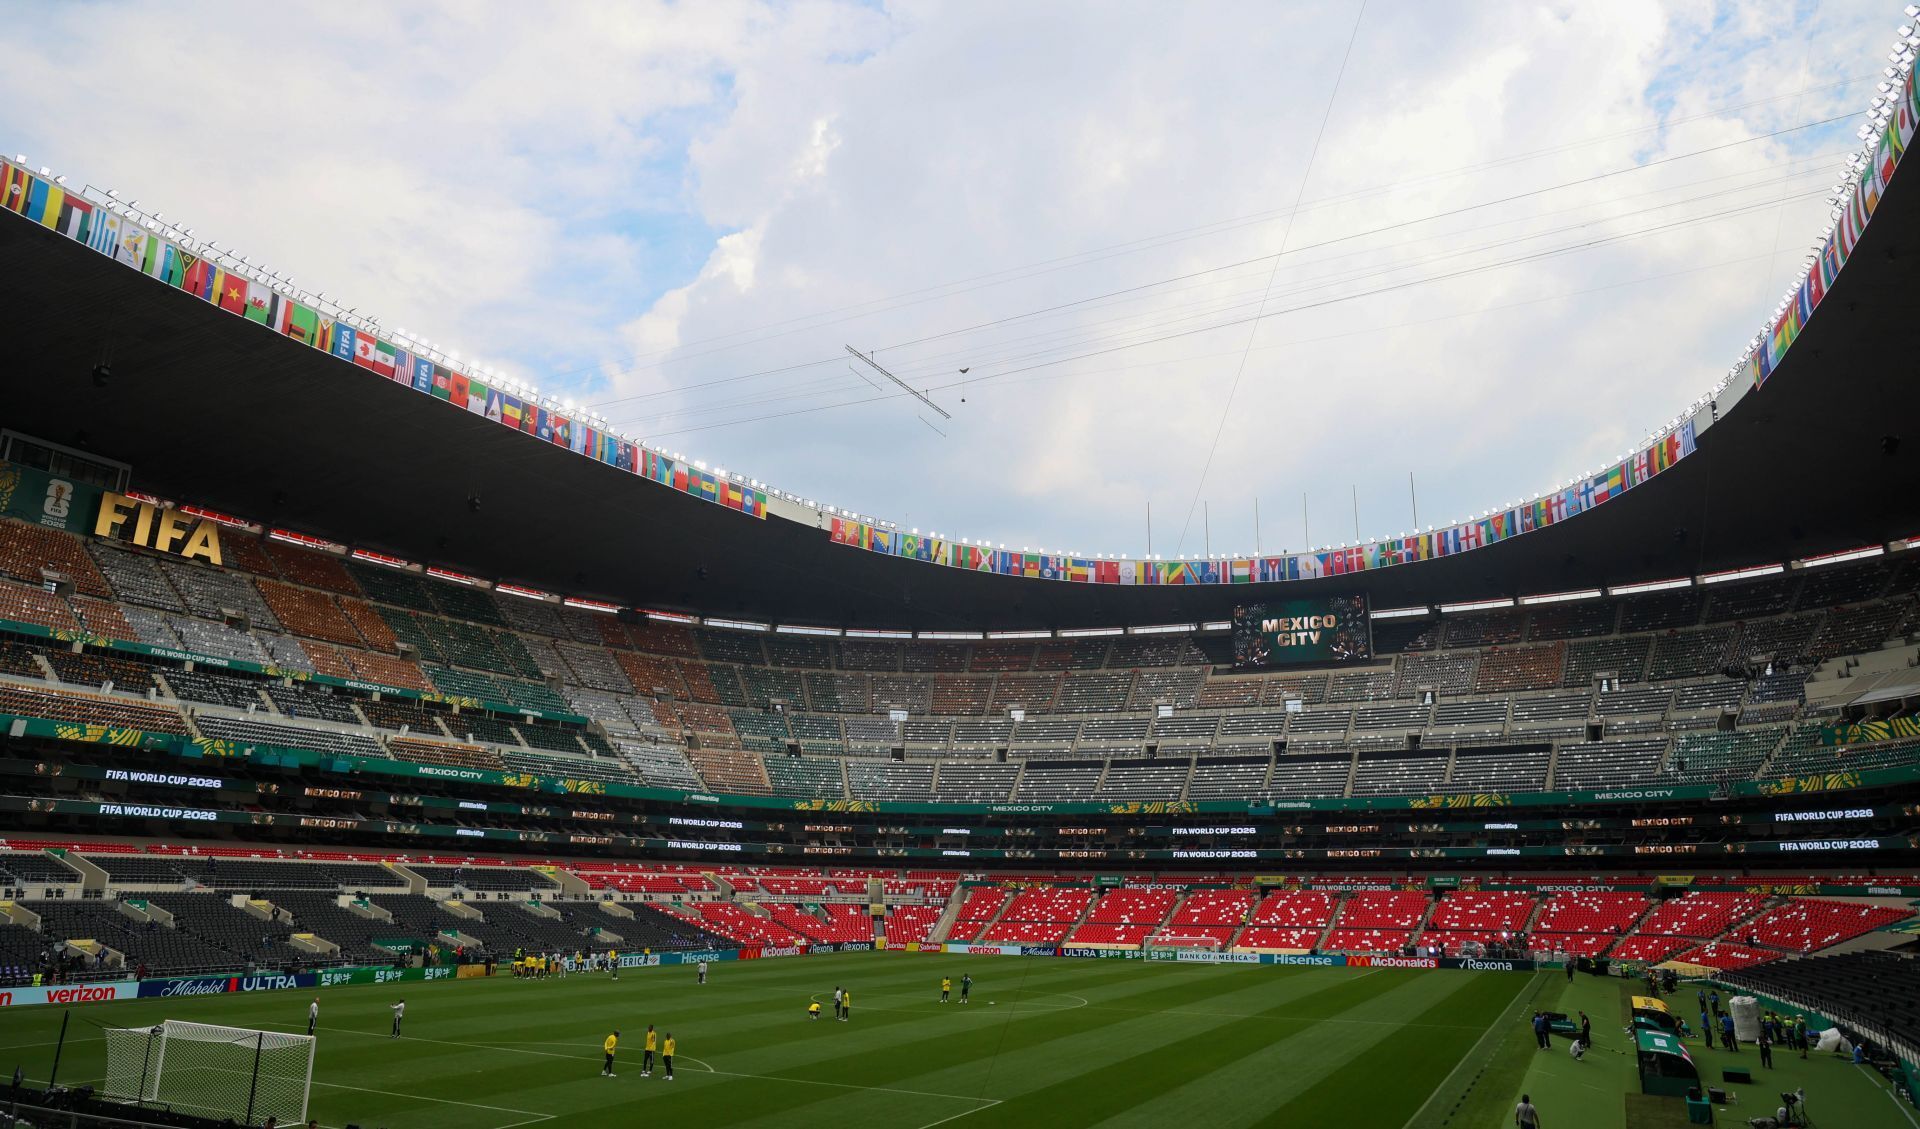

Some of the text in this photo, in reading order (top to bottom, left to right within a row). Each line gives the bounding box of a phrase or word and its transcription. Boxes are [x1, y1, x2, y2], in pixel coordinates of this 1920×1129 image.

[340, 330, 351, 356] FIFA
[418, 364, 429, 389] FIFA
[40, 518, 66, 529] 2026
[95, 491, 223, 566] FIFA
[1262, 614, 1336, 647] MEXICO CITY
[151, 648, 229, 667] FIFA WORLD CUP 2026
[345, 680, 401, 695] MEXICO CITY
[105, 769, 222, 789] FIFA WORLD CUP 2026
[418, 766, 483, 780] MEXICO CITY
[304, 788, 362, 800] MEXICO CITY
[1595, 789, 1674, 800] MEXICO CITY
[100, 804, 217, 821] FIFA WORLD CUP 2026
[572, 810, 615, 822] MEXICO CITY
[1775, 808, 1874, 822] FIFA WORLD CUP 2026
[300, 817, 358, 830] MEXICO CITY
[683, 819, 705, 827] WORLD
[706, 820, 719, 828] CUP
[719, 821, 743, 829] 2026
[1632, 817, 1694, 827] MEXICO CITY
[1172, 827, 1189, 835] FIFA
[1190, 827, 1214, 835] WORLD
[1215, 827, 1230, 835] CUP
[1326, 825, 1379, 833] MEXICO CITY
[570, 835, 613, 846] MEXICO CITY
[681, 842, 704, 851] WORLD
[704, 843, 717, 851] CUP
[1779, 839, 1880, 851] FIFA WORLD CUP 2026
[1231, 850, 1257, 858] 2026
[1634, 845, 1697, 854] MEXICO CITY
[760, 945, 800, 958] McDonald's
[812, 944, 834, 954] Rexona
[844, 942, 870, 951] Rexona
[919, 943, 941, 952] Sabritas
[968, 945, 1001, 955] verizon
[681, 952, 719, 964] Hisense
[1063, 948, 1097, 958] ULTRA
[1273, 954, 1332, 966] Hisense
[1370, 957, 1436, 968] McDonald's
[1467, 959, 1513, 970] Rexona
[161, 976, 297, 997] Michelob ULTRA
[46, 984, 116, 1003] verizon
